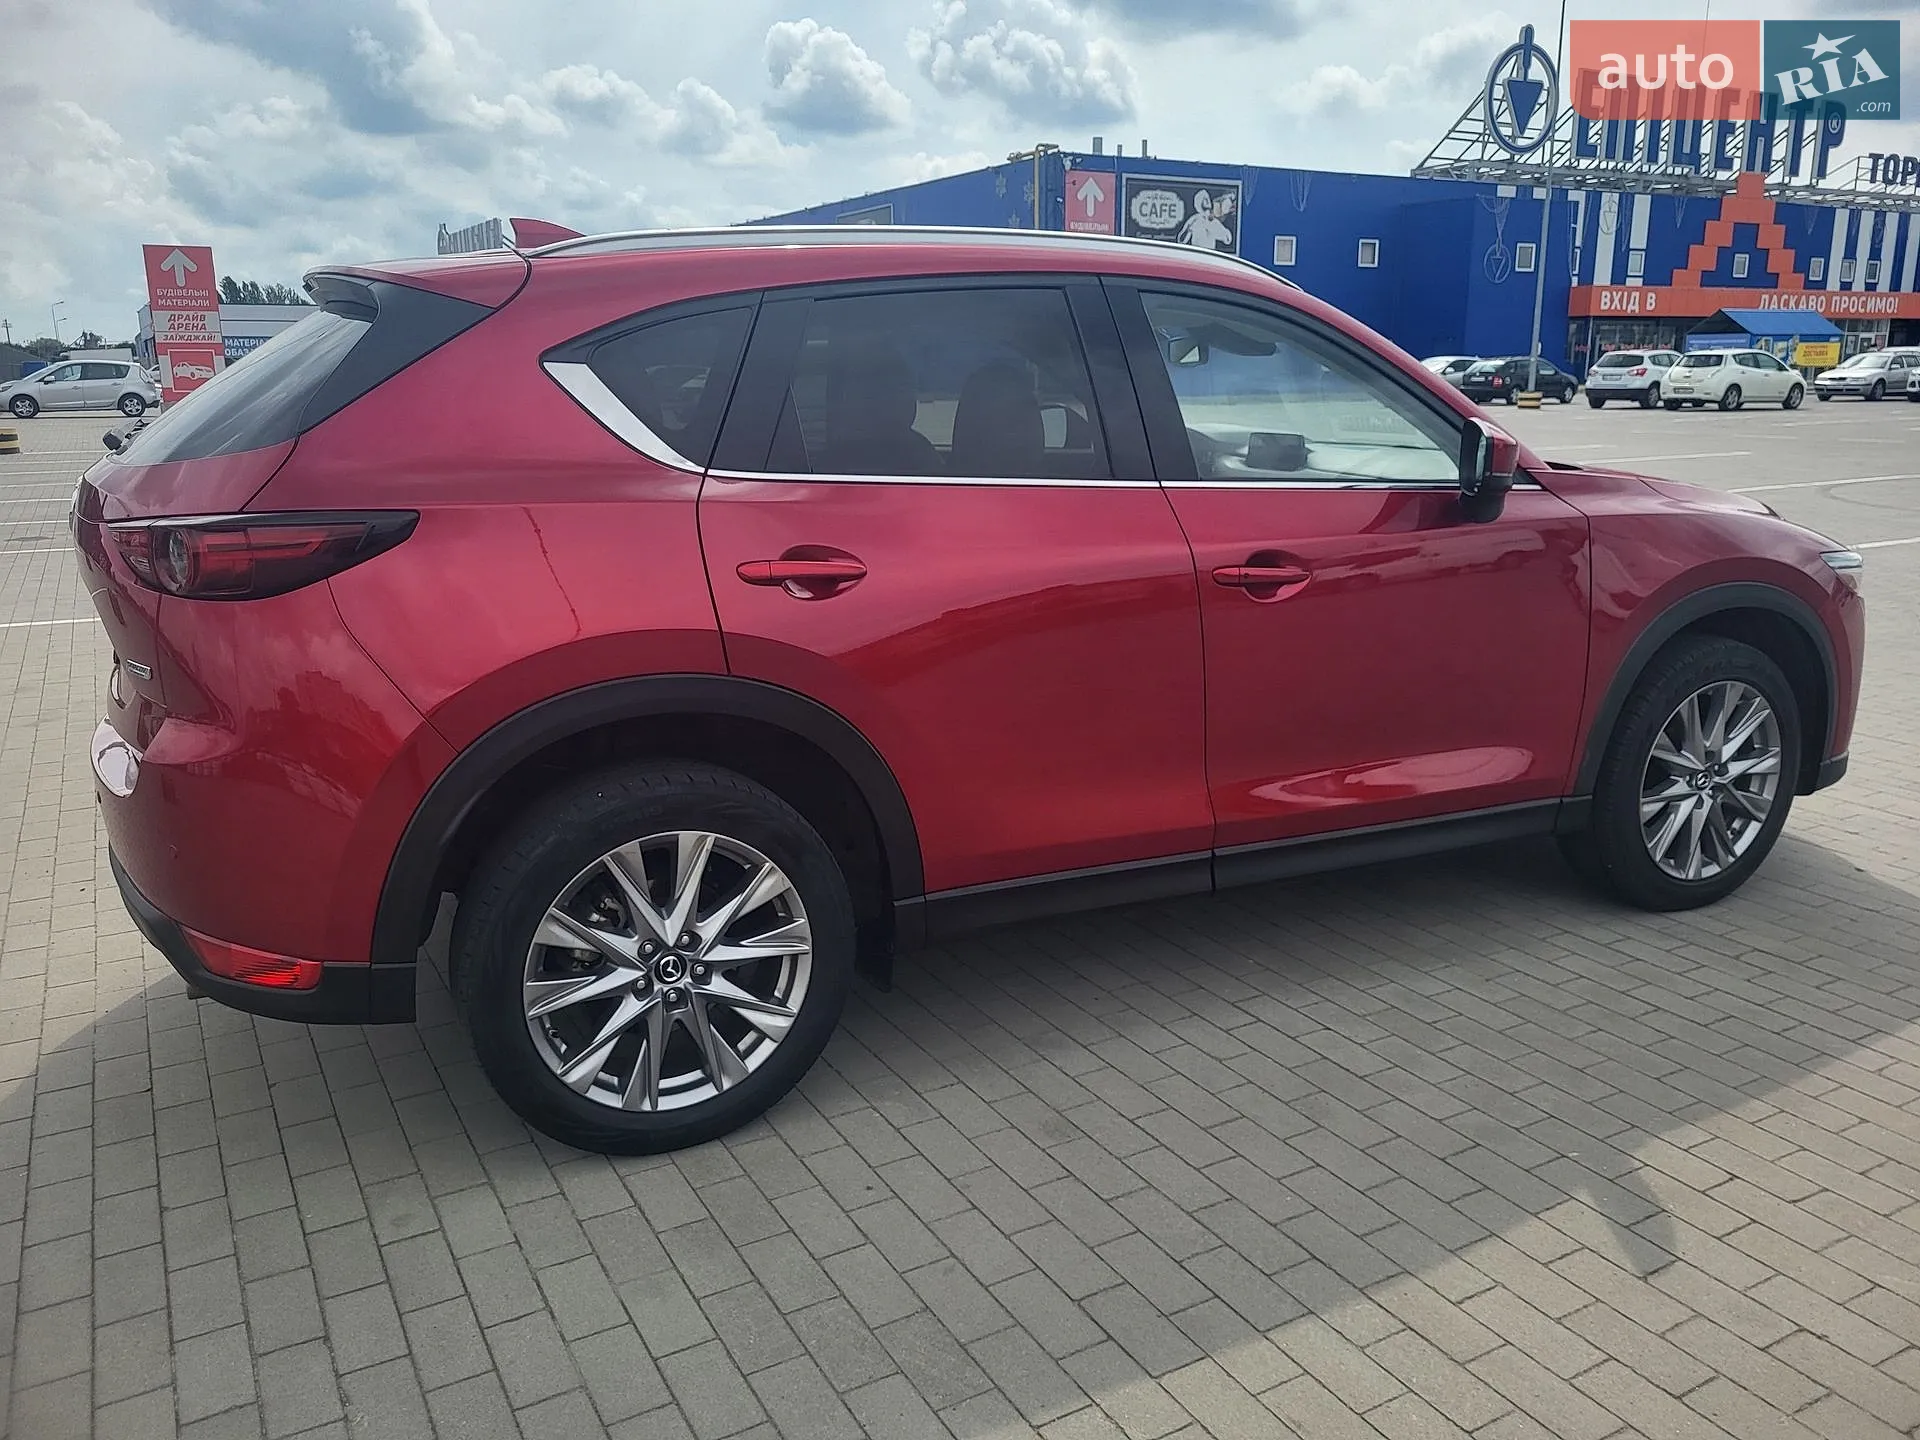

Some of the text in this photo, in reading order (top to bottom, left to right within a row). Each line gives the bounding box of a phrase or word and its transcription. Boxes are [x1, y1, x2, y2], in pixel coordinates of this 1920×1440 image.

[1571, 67, 1848, 180] ЕПІЦЕНТР
[1868, 153, 1920, 187] ТОР
[1138, 201, 1177, 219] CAFE
[157, 288, 209, 297] БУДІВЕЛЬНІ
[158, 298, 210, 307] МАТЕРІАЛИ
[1600, 290, 1657, 314] ВХІД В
[1758, 294, 1900, 314] ЛАСКАВО ПРОСИМО!
[168, 312, 207, 323] ДРАЙВ
[168, 322, 208, 331] АРЕНА
[162, 332, 216, 341] ЗАЇЖДЖАЙ!
